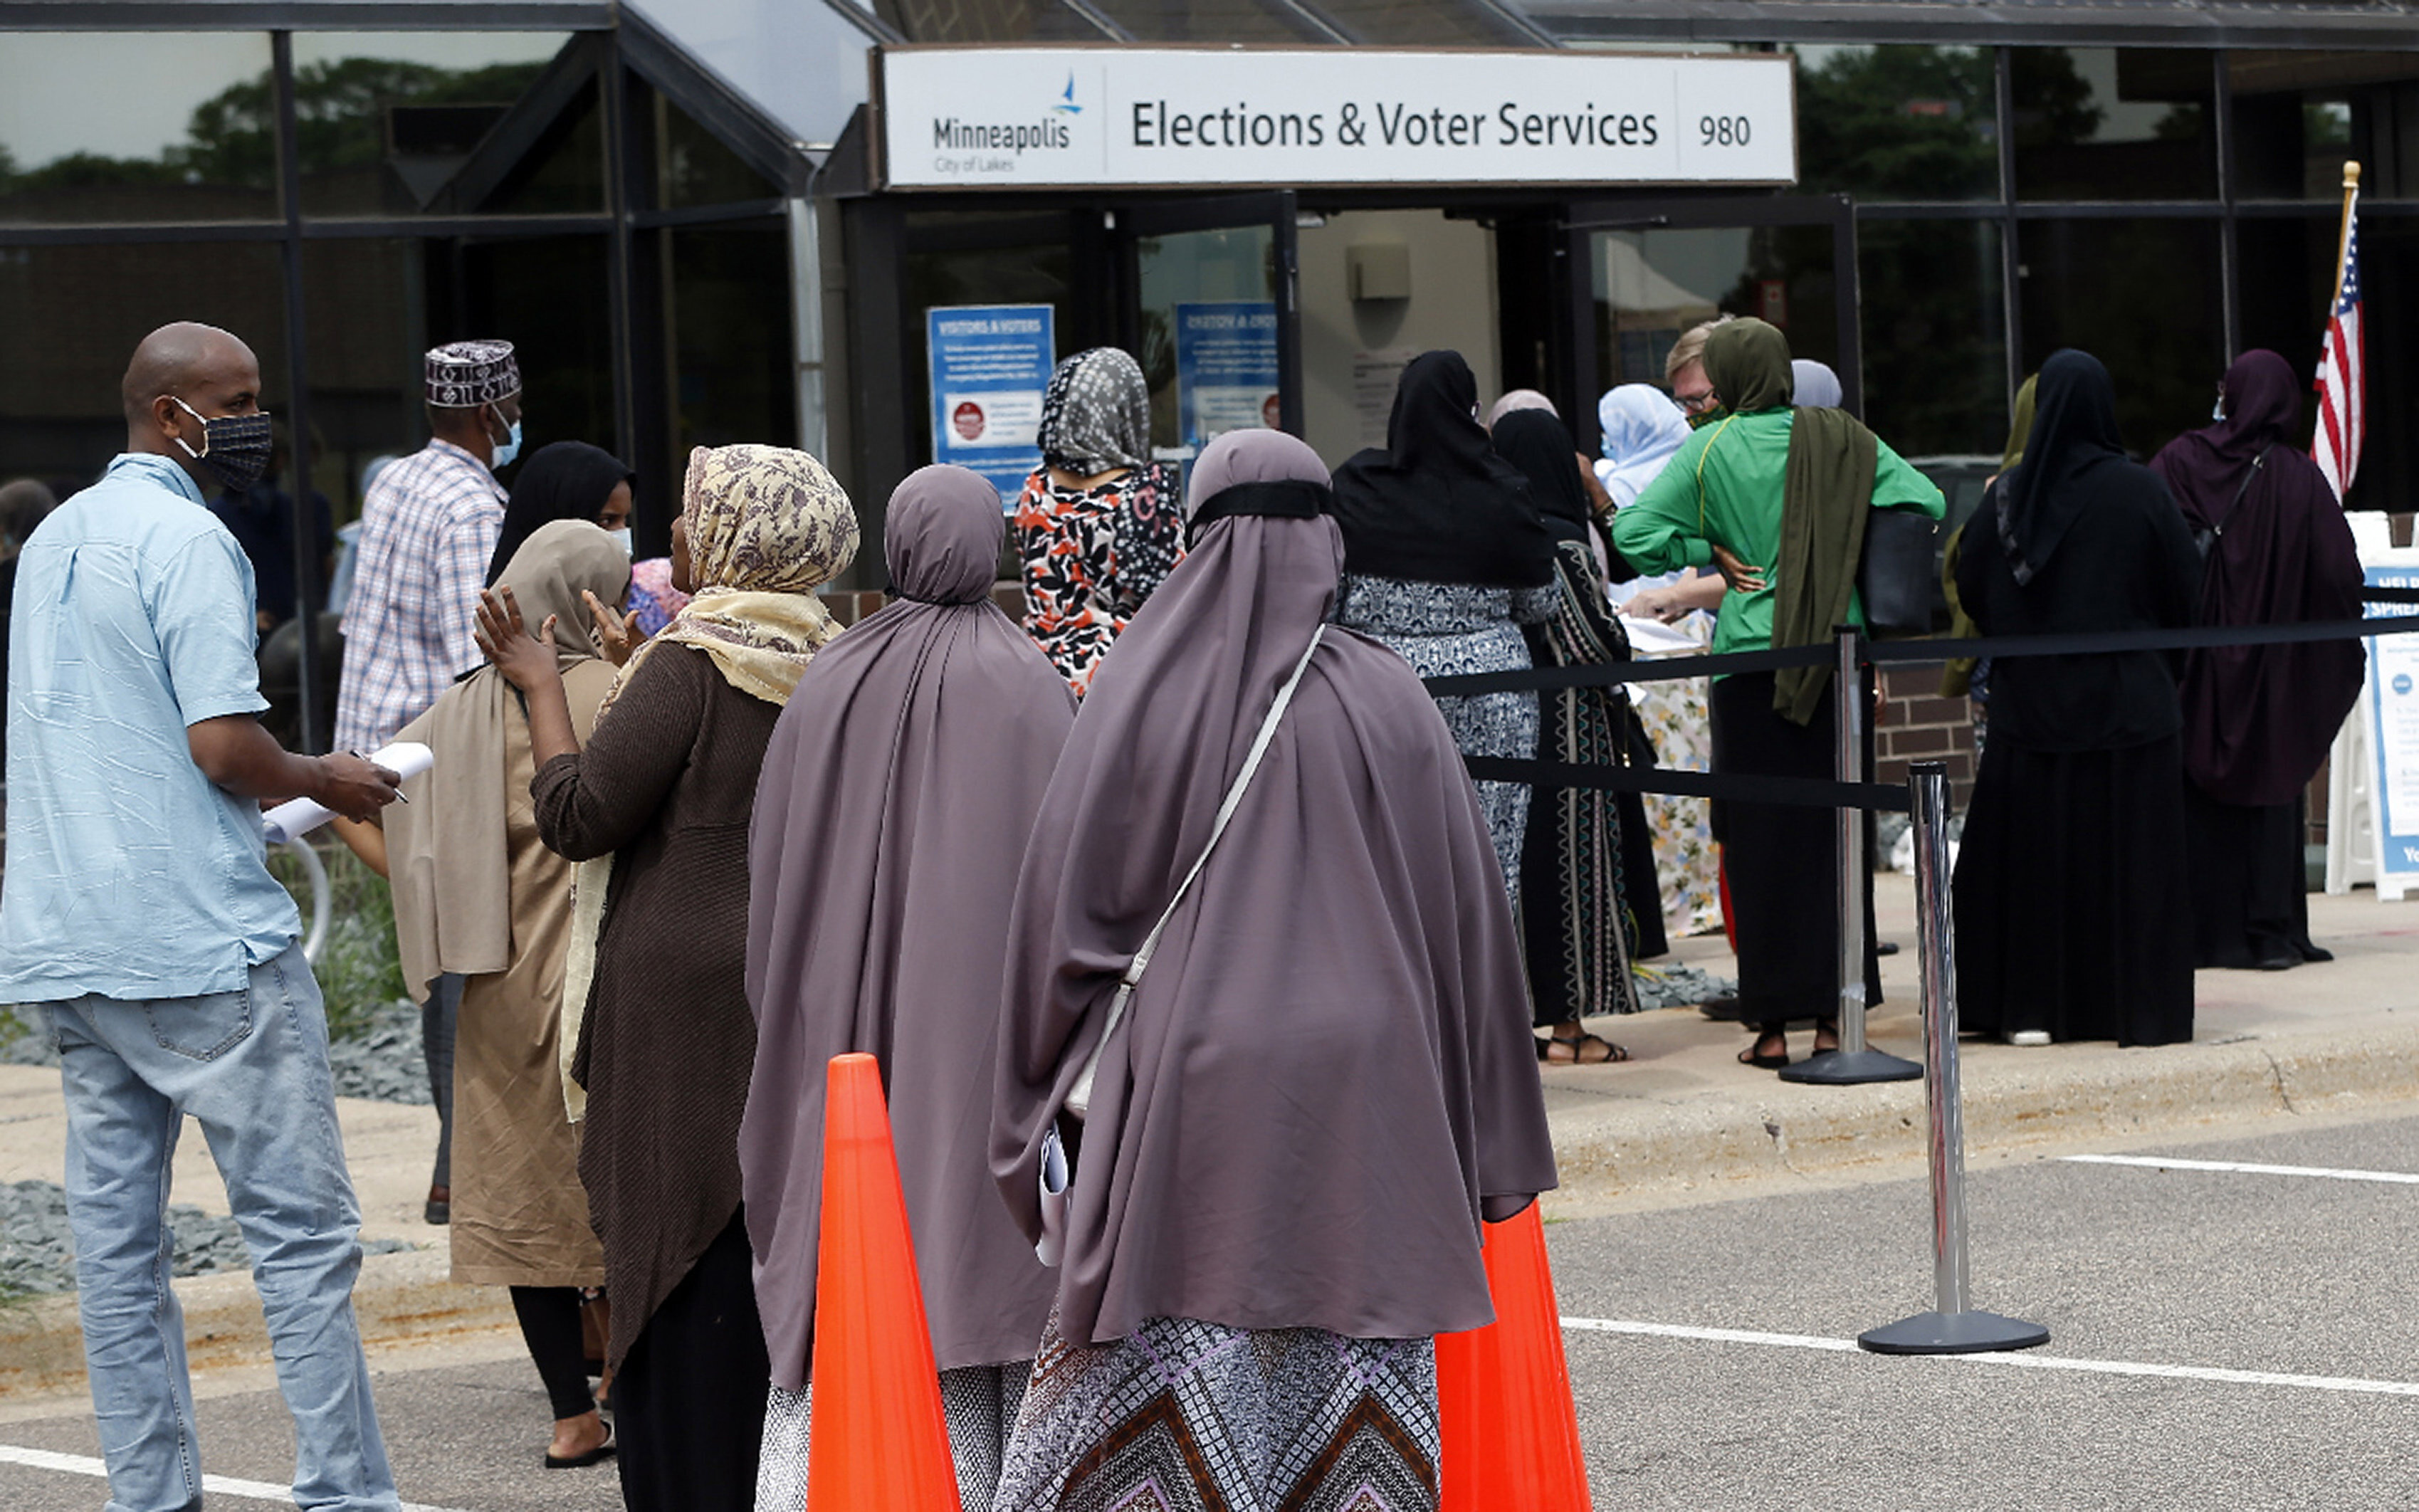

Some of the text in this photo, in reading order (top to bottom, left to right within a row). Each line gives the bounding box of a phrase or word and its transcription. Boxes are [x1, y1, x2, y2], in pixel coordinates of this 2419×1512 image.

[934, 117, 1070, 156] Minneapolis
[1133, 100, 1658, 147] Elections & Voter Services
[1699, 116, 1751, 147] 980
[934, 156, 1015, 174] City of Lakes
